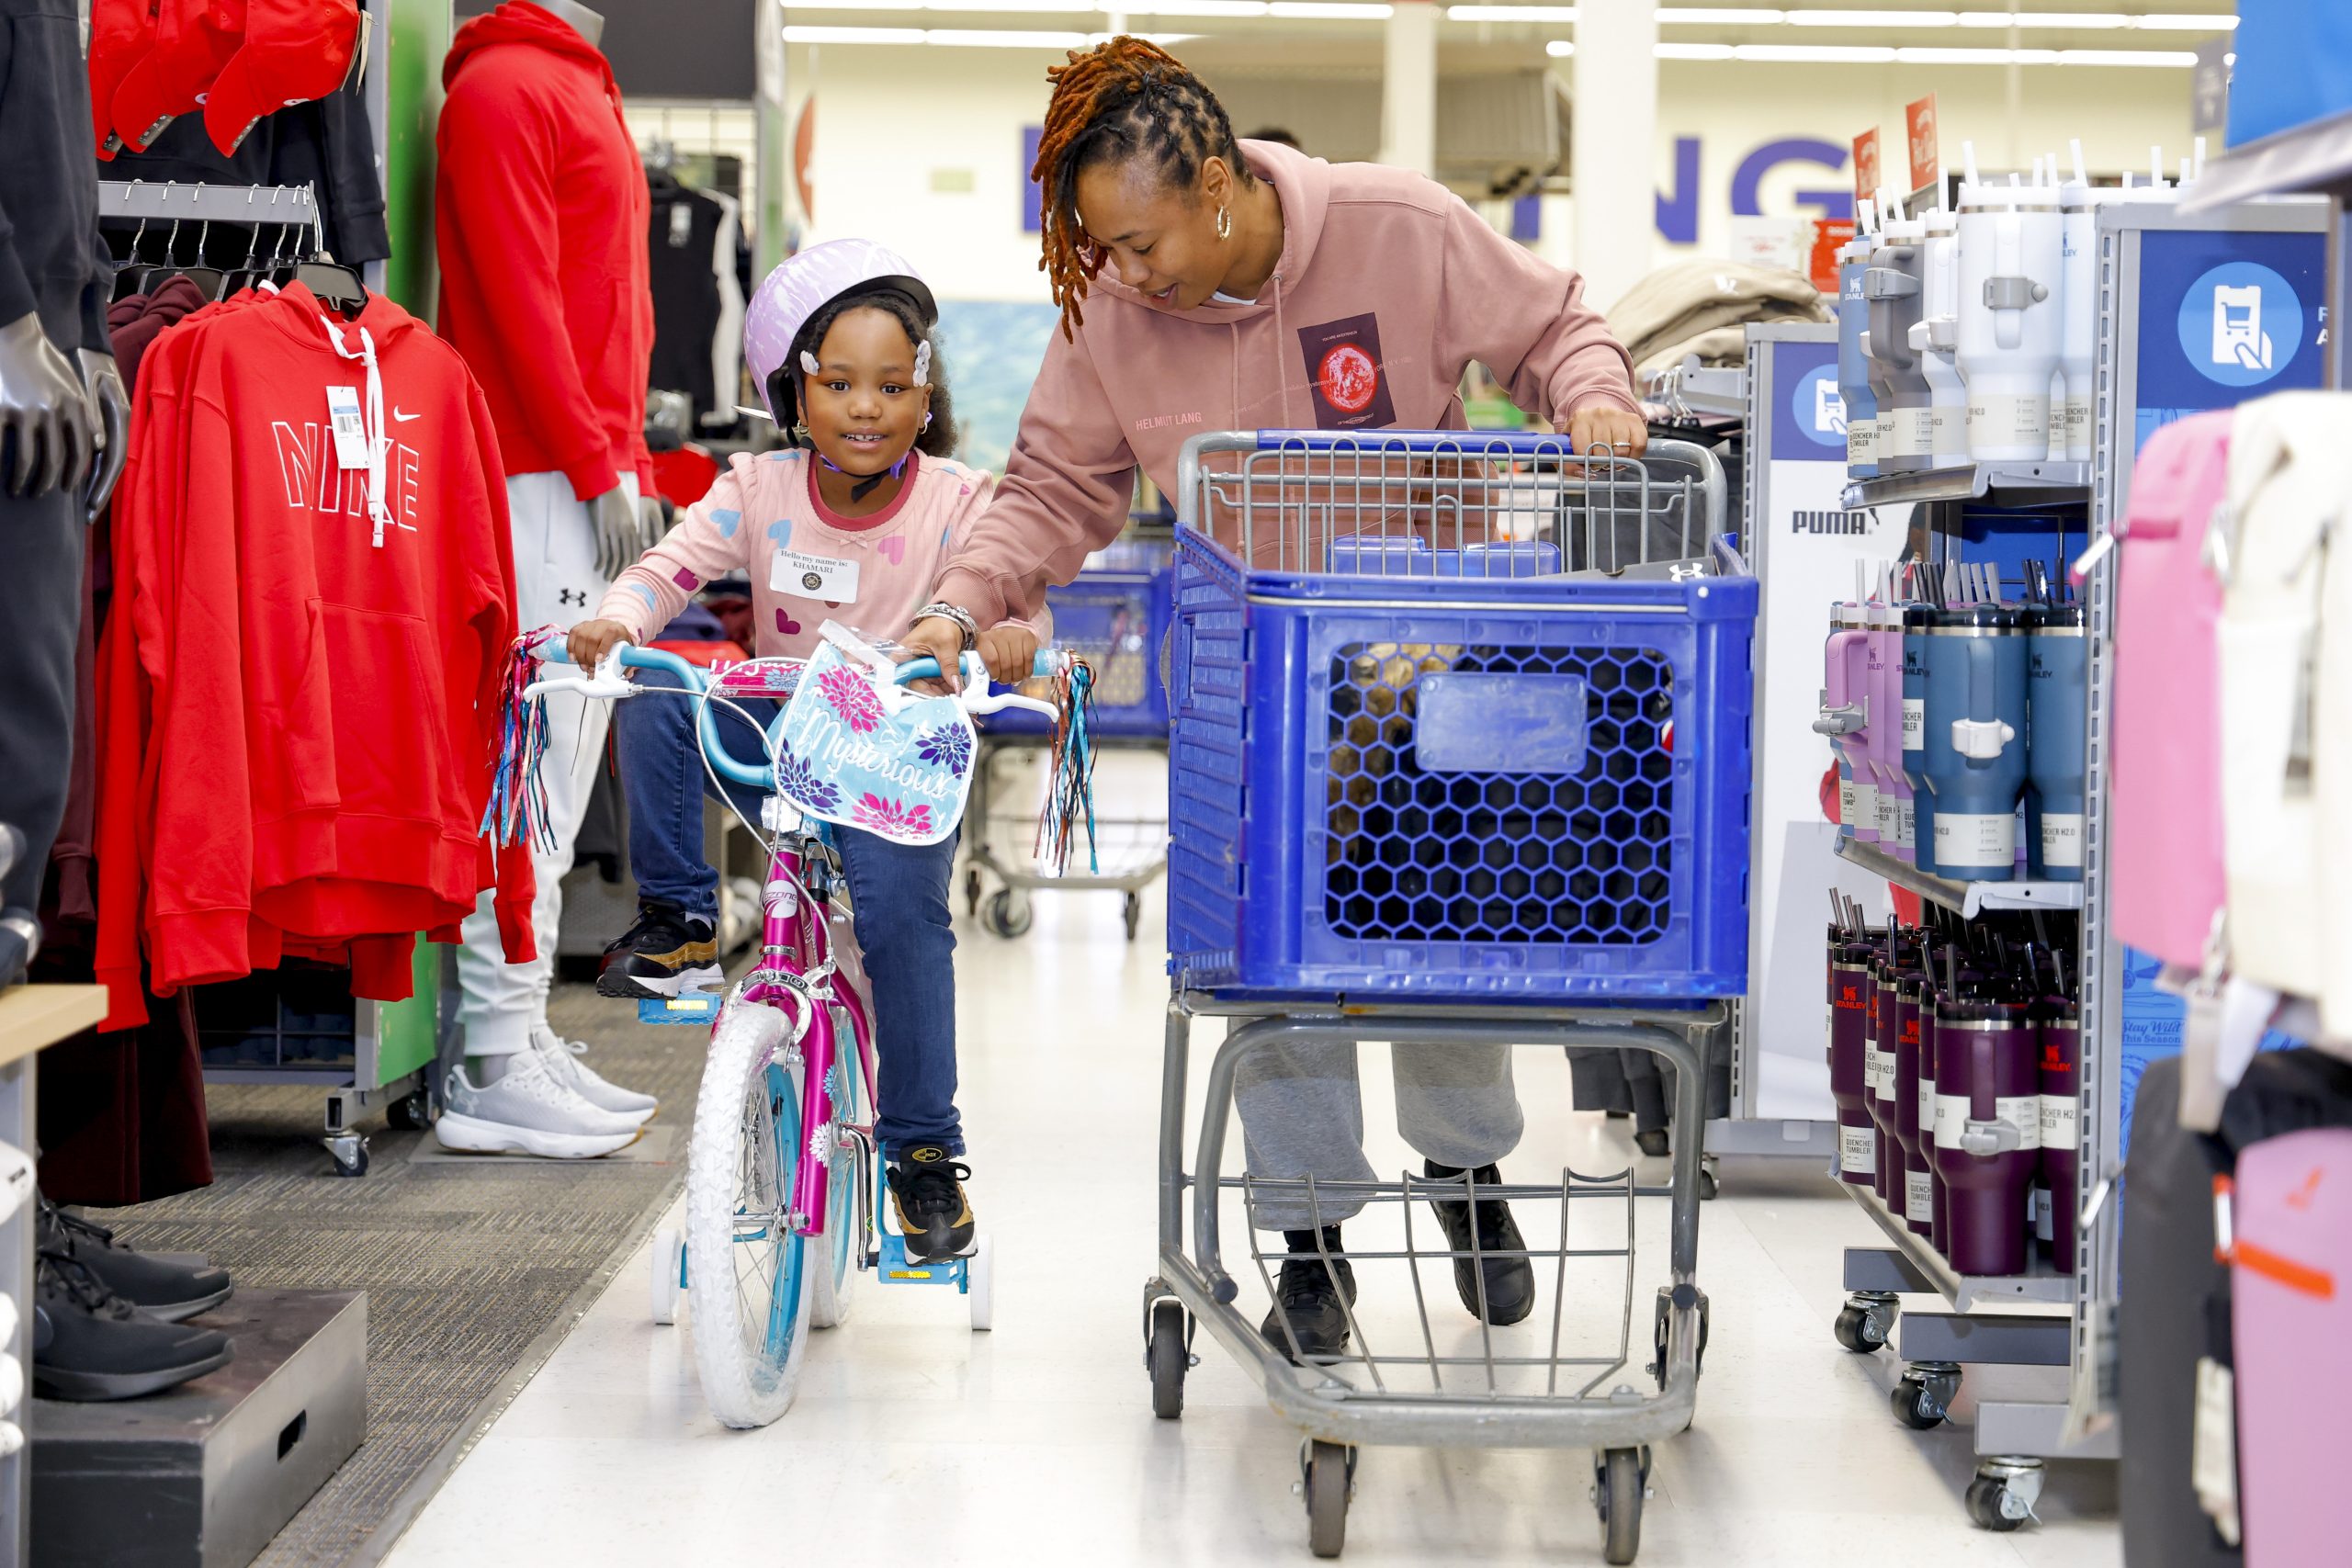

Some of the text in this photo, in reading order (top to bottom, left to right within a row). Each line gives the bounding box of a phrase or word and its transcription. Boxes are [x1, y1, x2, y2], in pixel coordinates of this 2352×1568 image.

[1136, 412, 1203, 431] HELMUT LANG
[1792, 511, 1866, 535] PUMA
[781, 549, 849, 568] Hello my name is:
[793, 560, 834, 574] KHAMARI
[801, 706, 952, 800] Mysterious
[1836, 999, 1867, 1010] STANLEY
[1846, 1145, 1871, 1156] TUMBLER
[1910, 1184, 1931, 1193] QUENCH
[1910, 1192, 1932, 1201] TUMBLE
